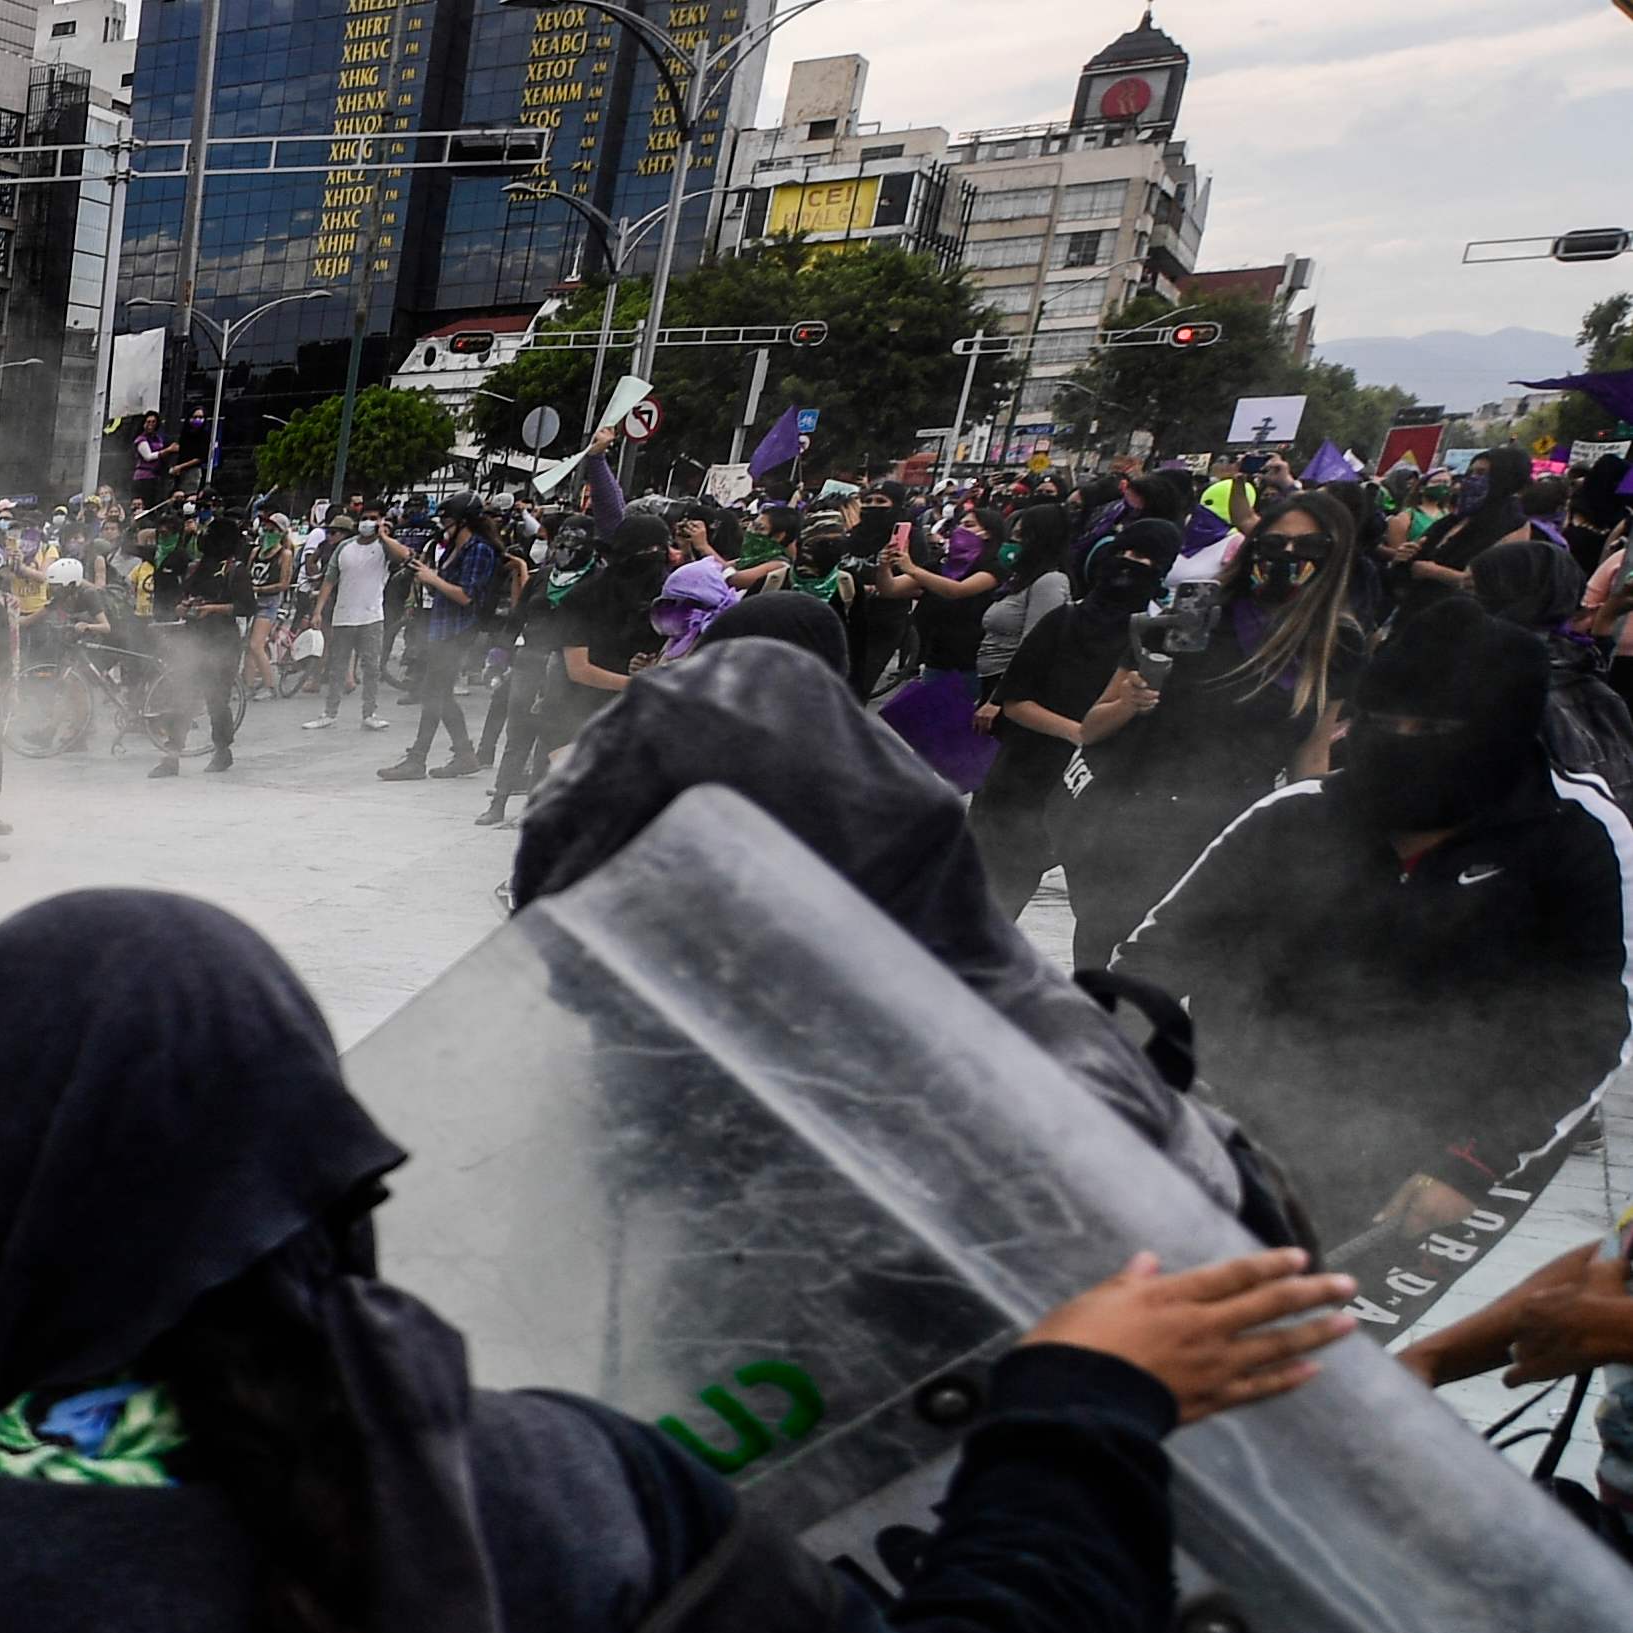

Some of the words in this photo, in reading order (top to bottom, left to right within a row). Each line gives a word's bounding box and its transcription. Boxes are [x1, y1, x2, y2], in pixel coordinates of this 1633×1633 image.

[344, 15, 392, 40] XHFRT
[408, 18, 422, 31] FM
[532, 6, 588, 33] XEVOX
[341, 38, 391, 63] XHEVC
[405, 41, 419, 55] FM
[528, 31, 589, 58] XEABCJ
[337, 66, 379, 89] XHKG
[401, 68, 415, 81] FM
[525, 58, 577, 82] XETOT
[334, 90, 387, 114] XHENX
[398, 93, 412, 107] FM
[520, 81, 583, 108] XEMMM
[395, 117, 409, 131] FM
[322, 185, 374, 209] XHTOT
[385, 189, 399, 201] FM
[319, 209, 363, 232] XHXC
[382, 212, 396, 224] FM
[316, 232, 355, 256] XHJH
[379, 235, 392, 248] FM
[312, 255, 350, 280] XEJH
[372, 259, 389, 272] AM
